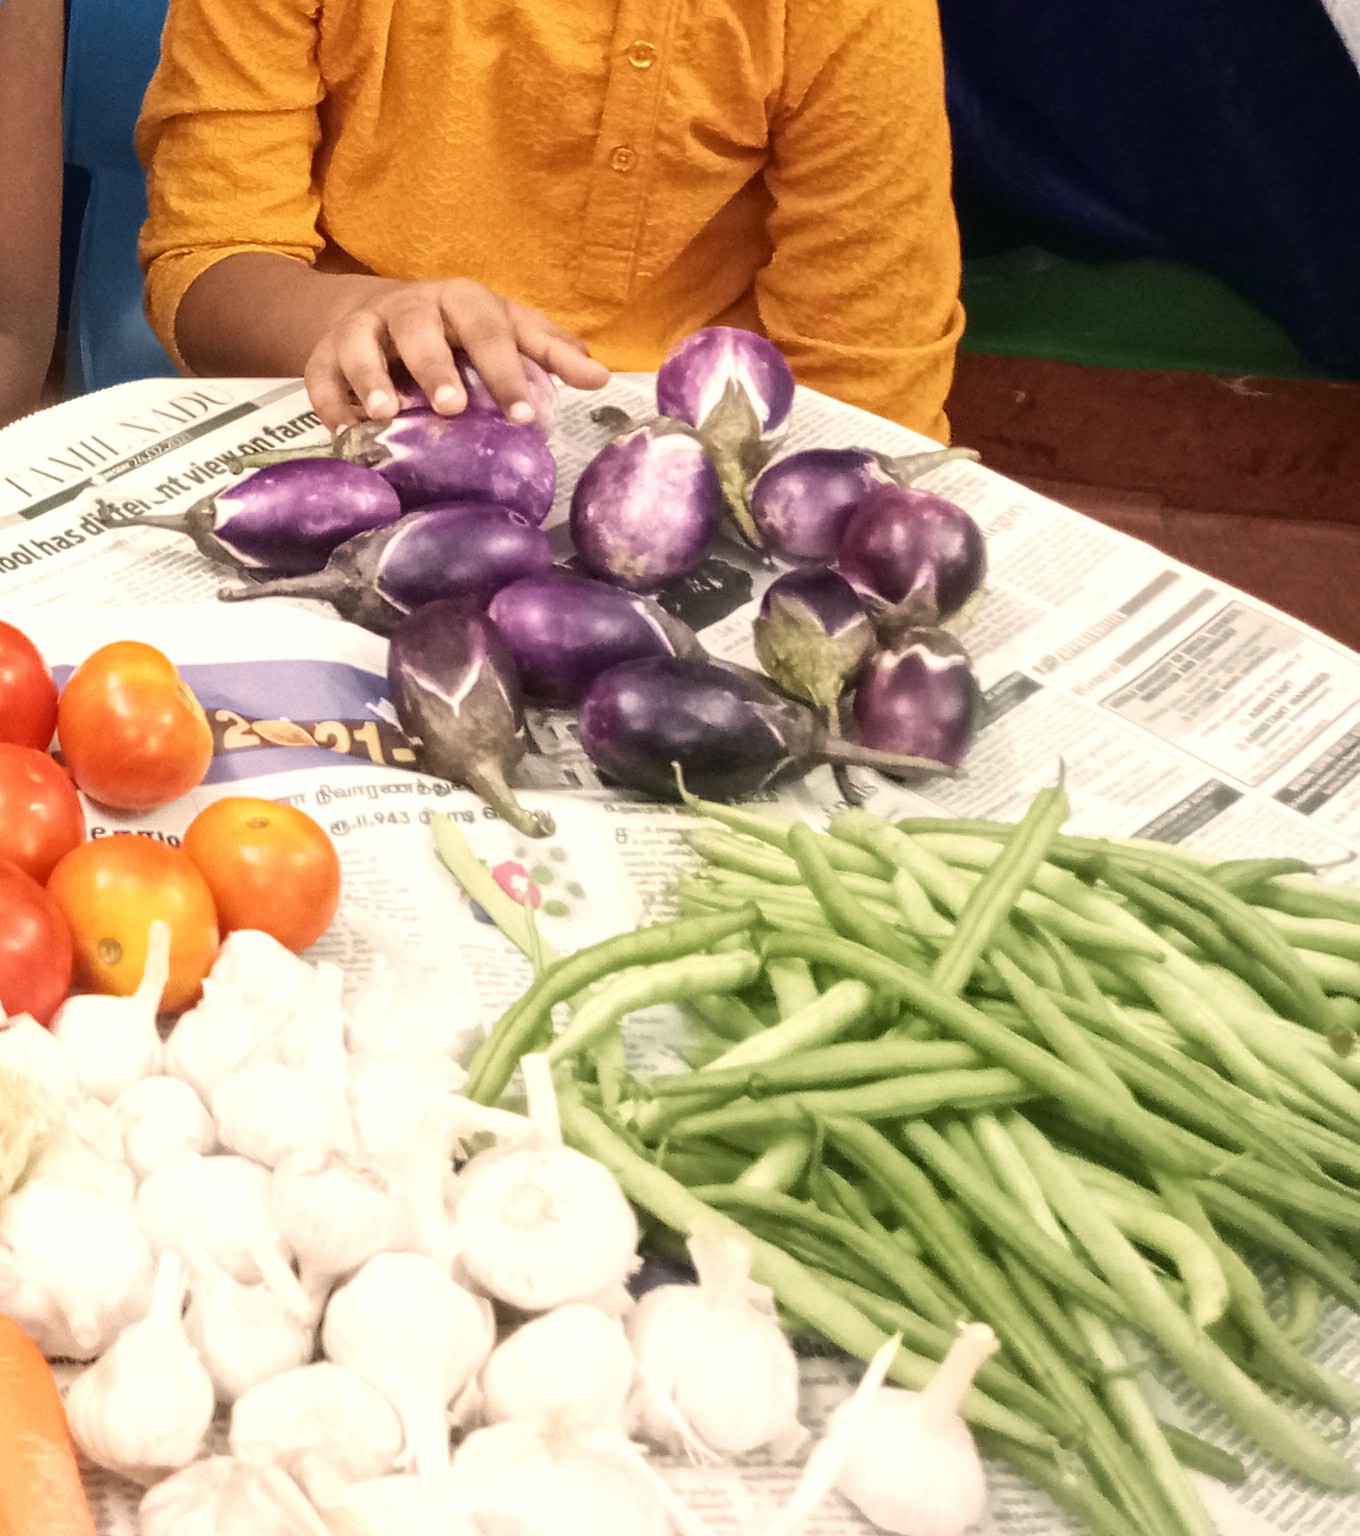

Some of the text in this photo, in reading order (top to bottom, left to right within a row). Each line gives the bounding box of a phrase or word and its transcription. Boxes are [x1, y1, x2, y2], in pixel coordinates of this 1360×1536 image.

[122, 370, 235, 451] NADU
[38, 522, 85, 561] has
[184, 443, 244, 489] view
